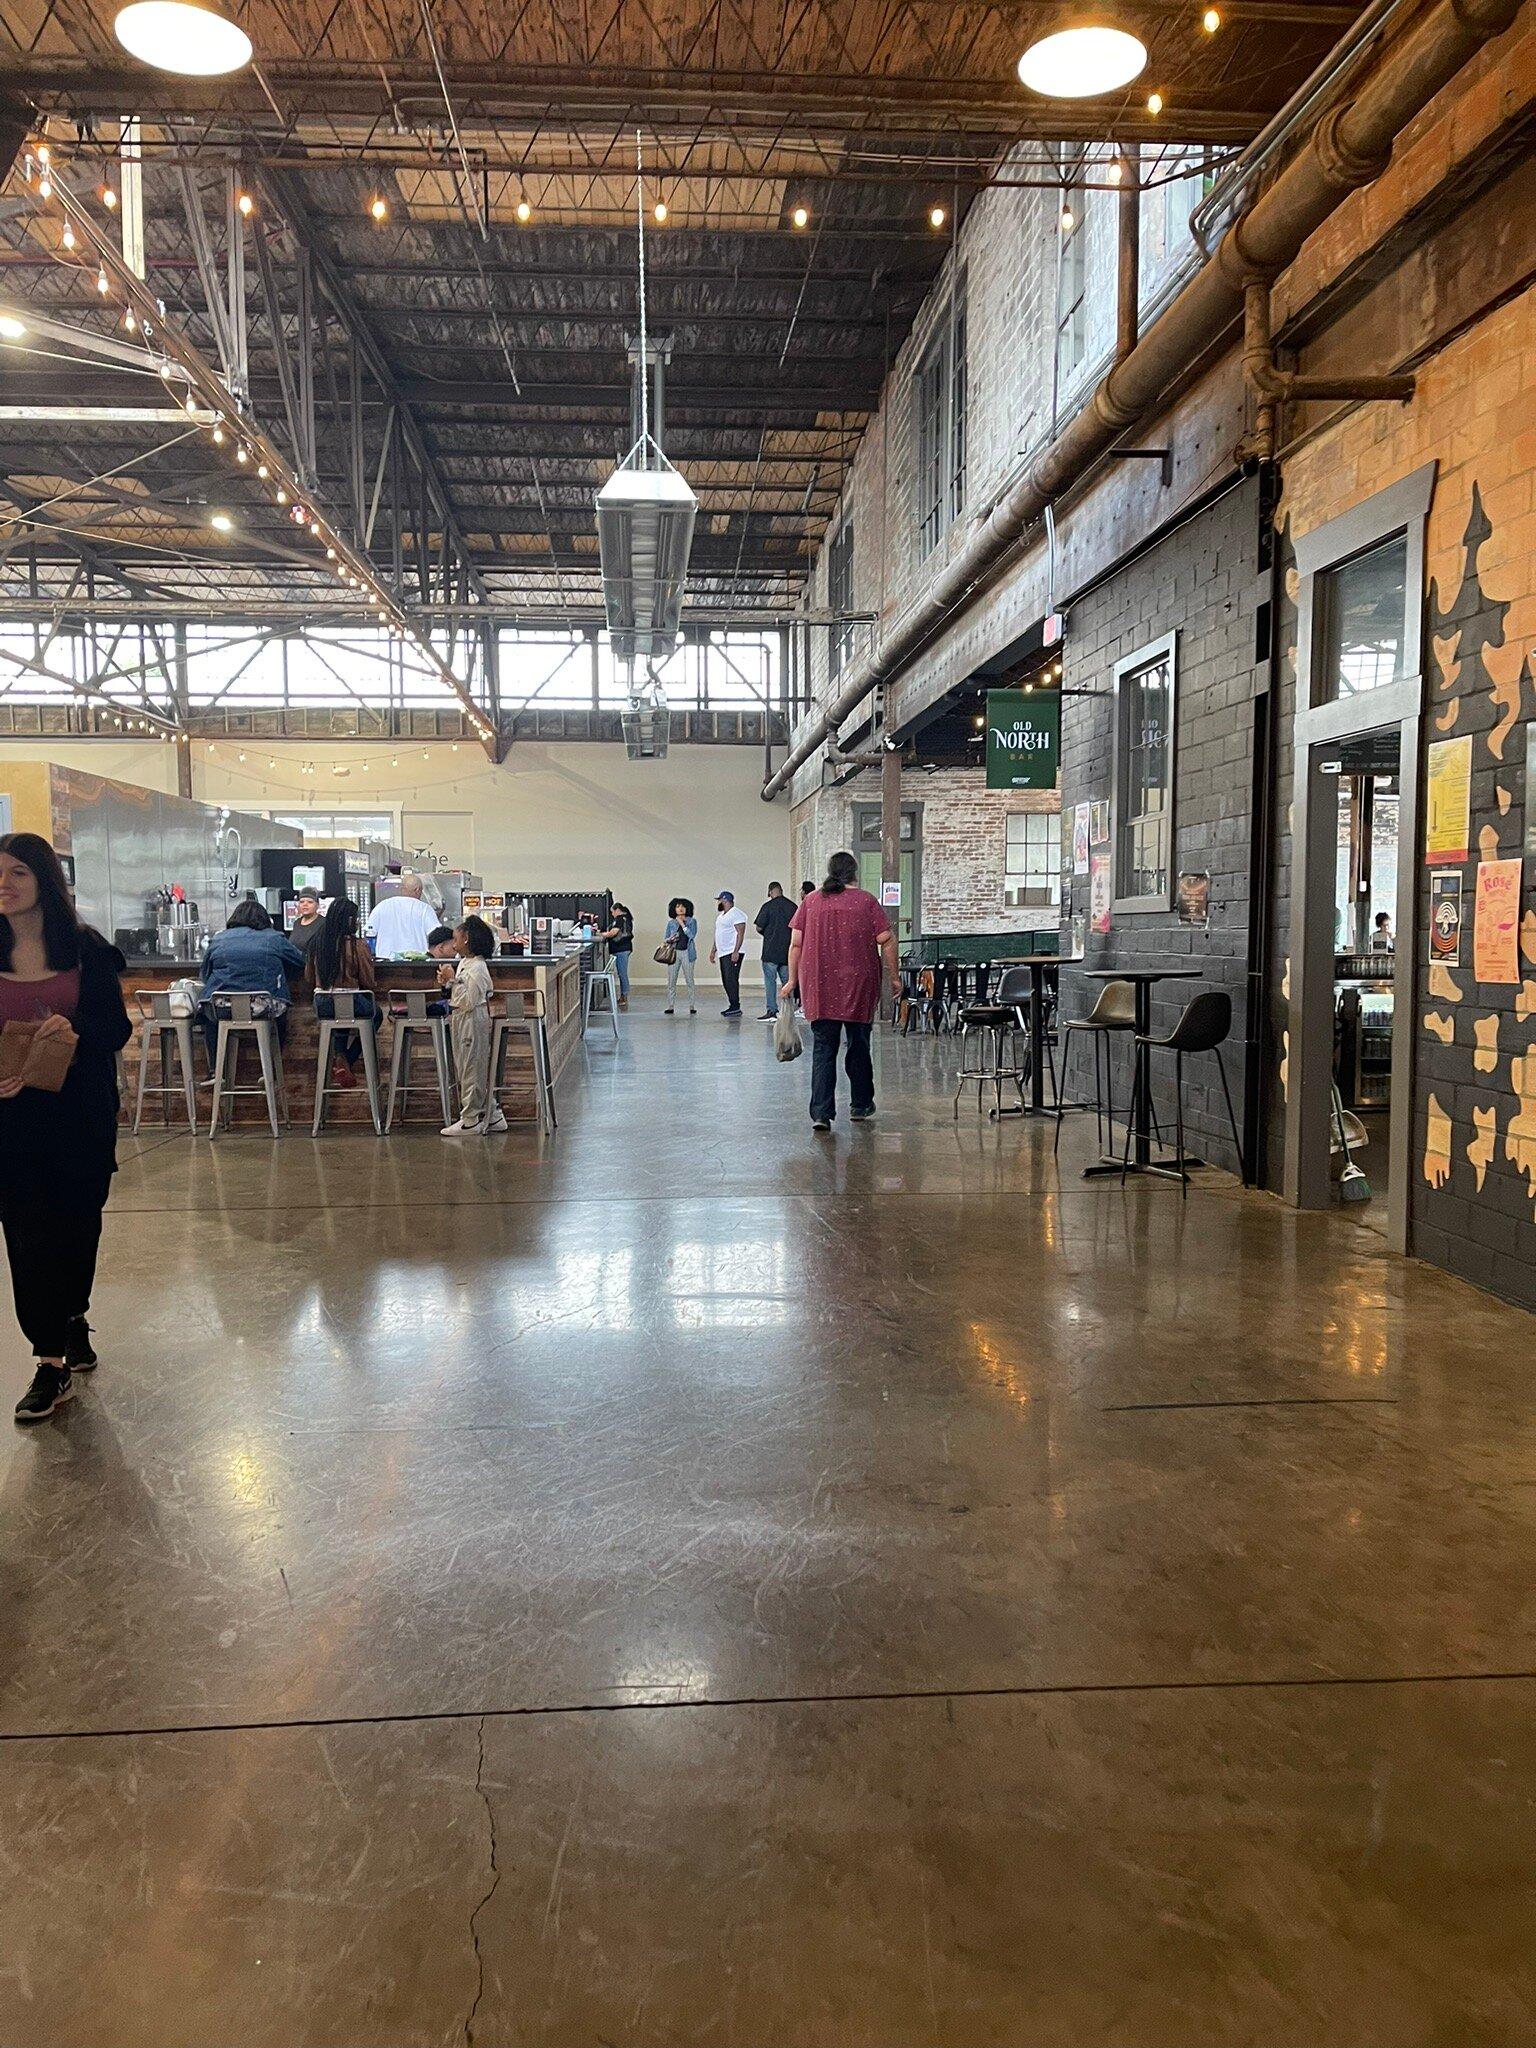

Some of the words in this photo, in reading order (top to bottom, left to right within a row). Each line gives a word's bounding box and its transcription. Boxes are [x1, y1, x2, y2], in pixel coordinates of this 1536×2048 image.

[1013, 721, 1032, 731] OLD
[990, 728, 1049, 750] NORTH
[1009, 753, 1034, 761] BAR
